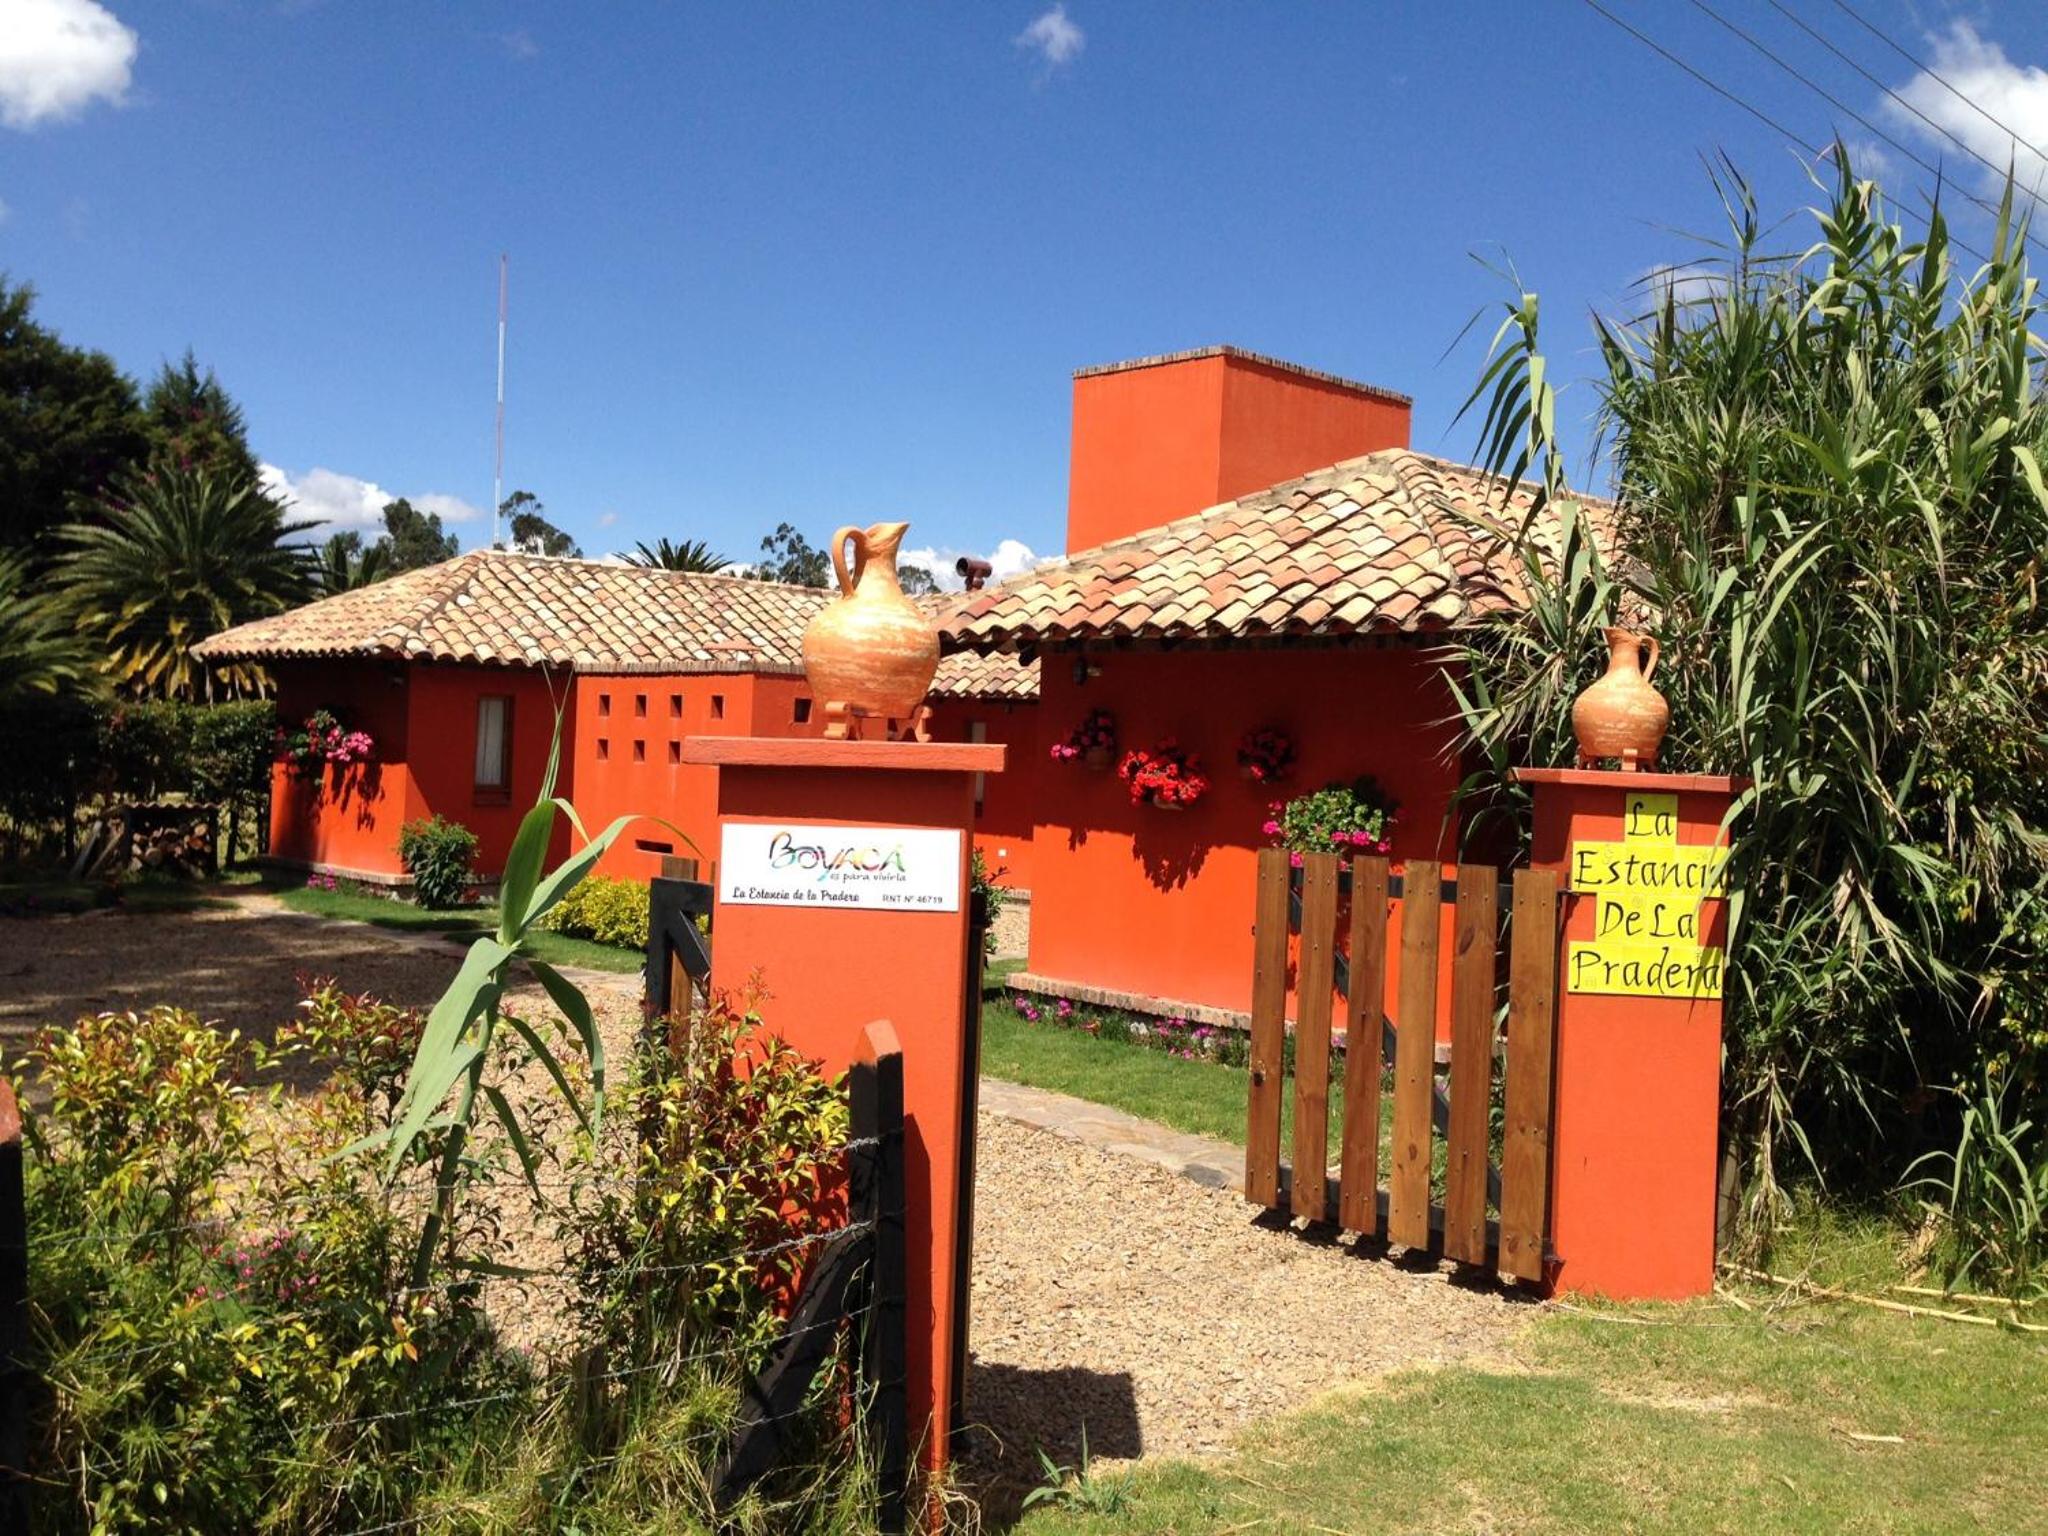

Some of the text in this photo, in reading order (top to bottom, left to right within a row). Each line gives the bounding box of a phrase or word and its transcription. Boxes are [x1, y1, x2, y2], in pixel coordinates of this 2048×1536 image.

[1627, 802, 1674, 837] La
[843, 873, 870, 883] para
[732, 886, 860, 902] La Estancia de la Pradera
[882, 894, 901, 903] RNT
[1599, 901, 1697, 939] De La
[1572, 946, 1721, 994] Pradera
